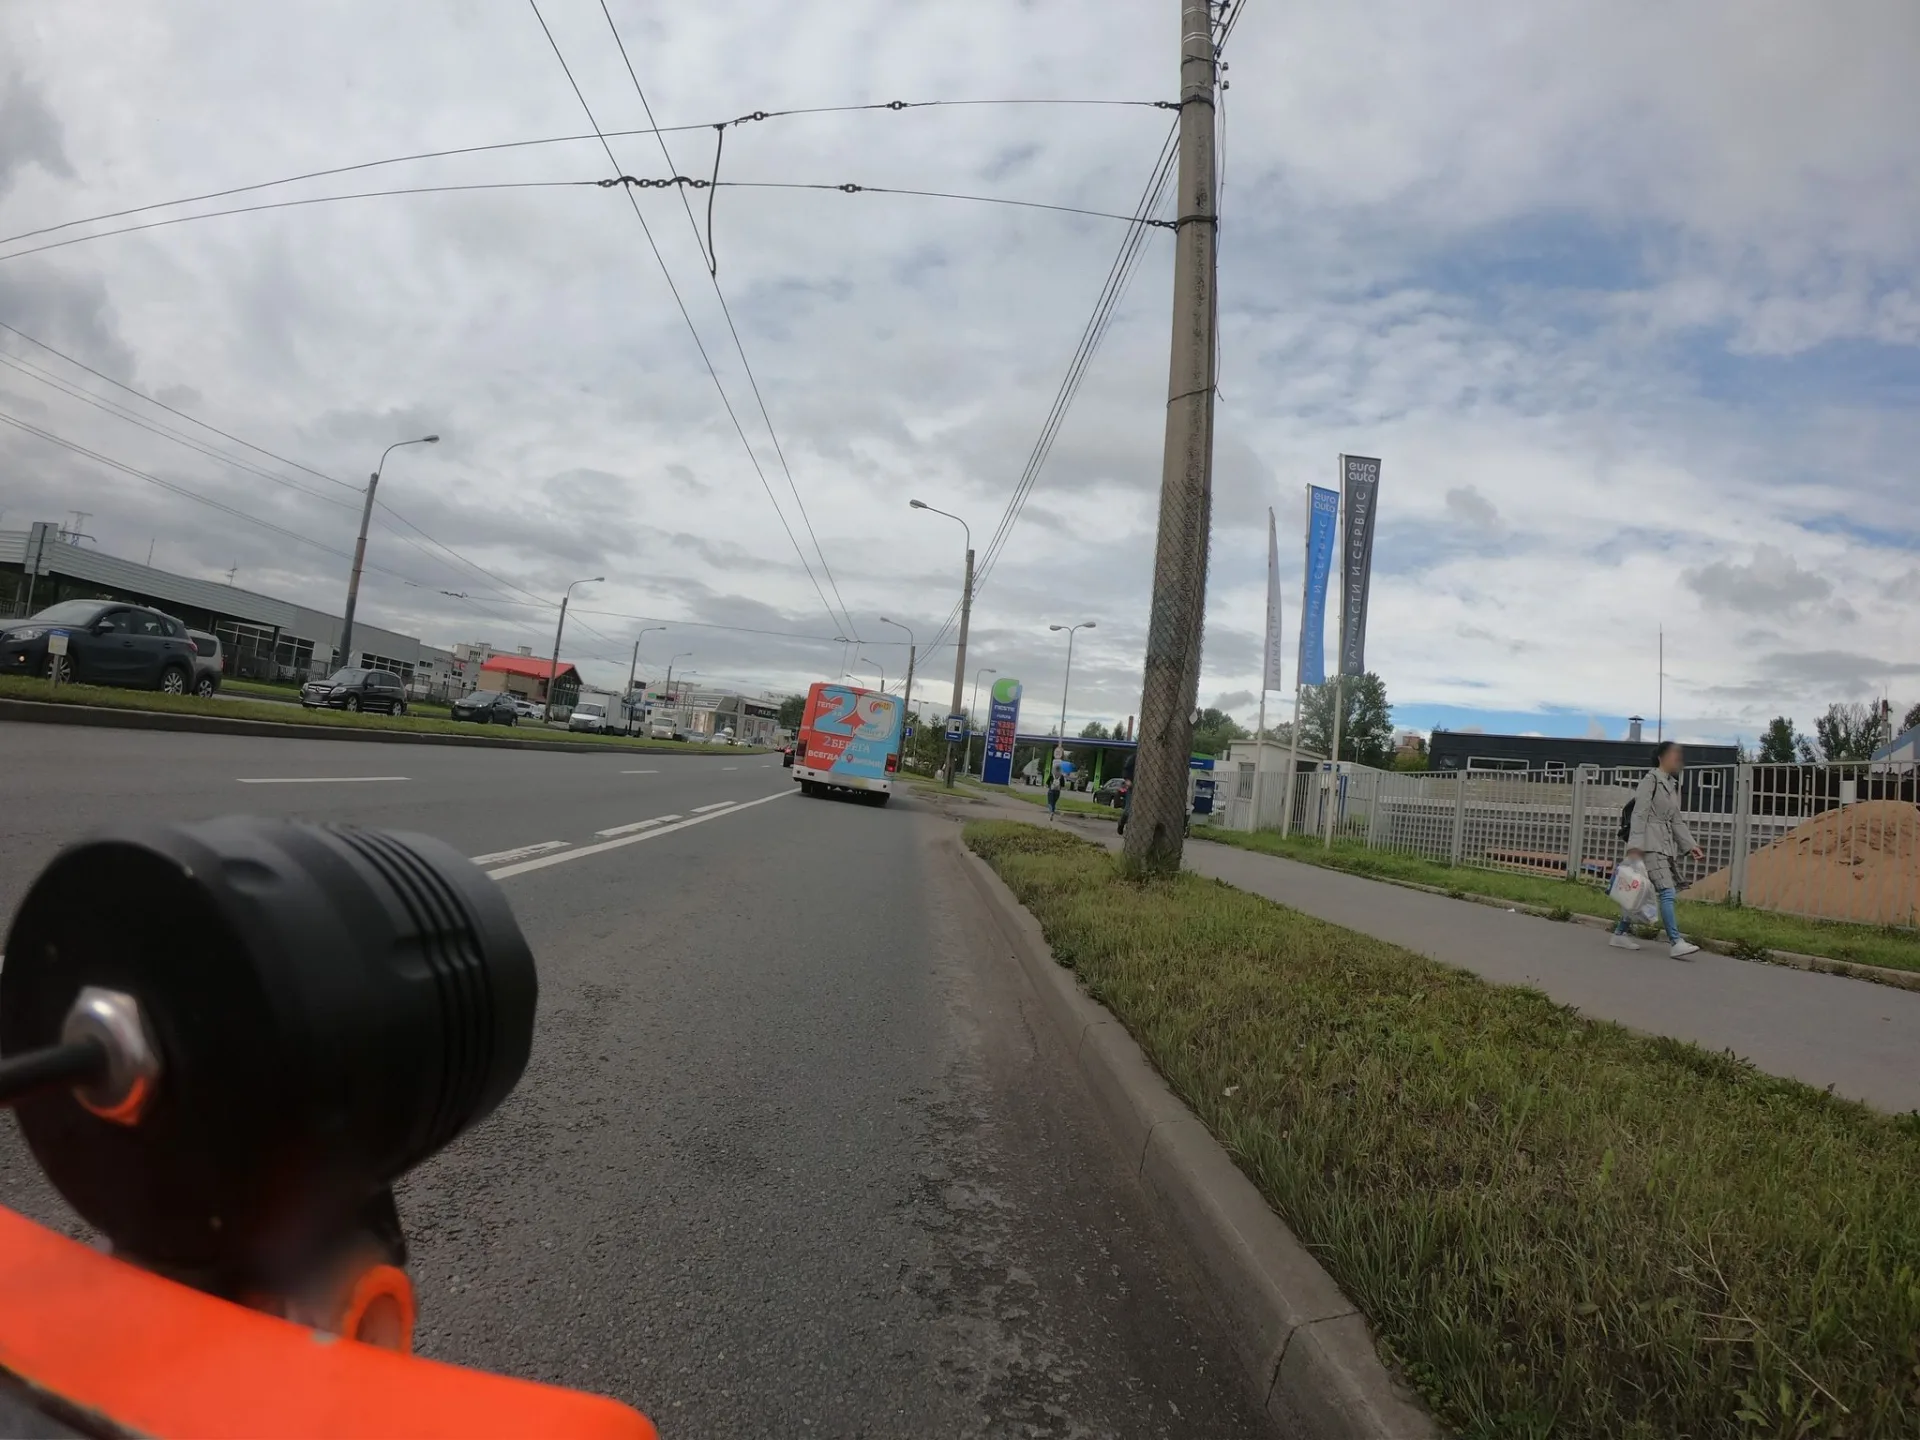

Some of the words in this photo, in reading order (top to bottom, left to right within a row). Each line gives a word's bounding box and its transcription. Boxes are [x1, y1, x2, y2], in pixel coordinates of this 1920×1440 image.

[1348, 461, 1377, 473] euro
[1348, 471, 1377, 484] auto
[1313, 491, 1336, 504] euro
[1313, 501, 1336, 513] auto
[1352, 491, 1367, 560] СЕРВИС
